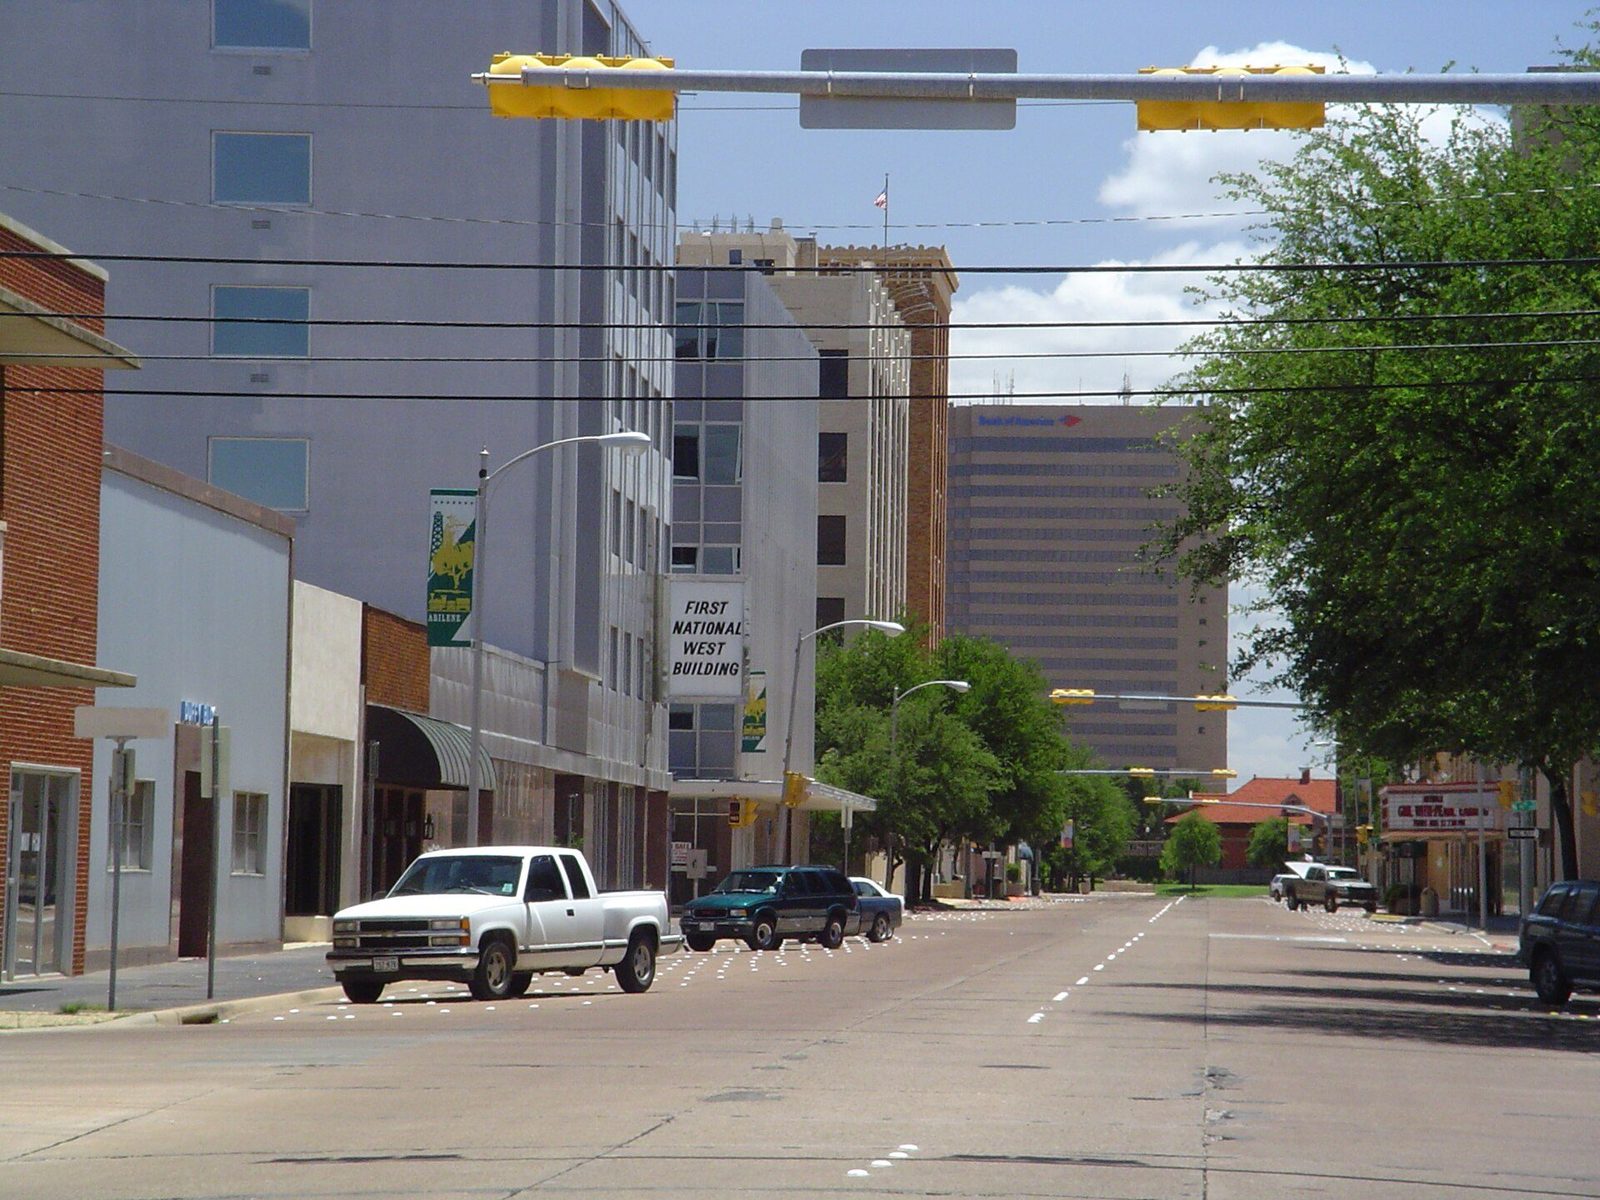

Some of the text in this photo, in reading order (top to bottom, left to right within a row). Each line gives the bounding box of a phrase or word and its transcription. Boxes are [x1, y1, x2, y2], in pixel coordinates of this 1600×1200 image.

[685, 601, 728, 615] FIRST
[428, 614, 461, 622] ABILENE
[673, 621, 741, 635] NATIONAL
[684, 642, 726, 655] WEST
[673, 662, 739, 676] BUILDING
